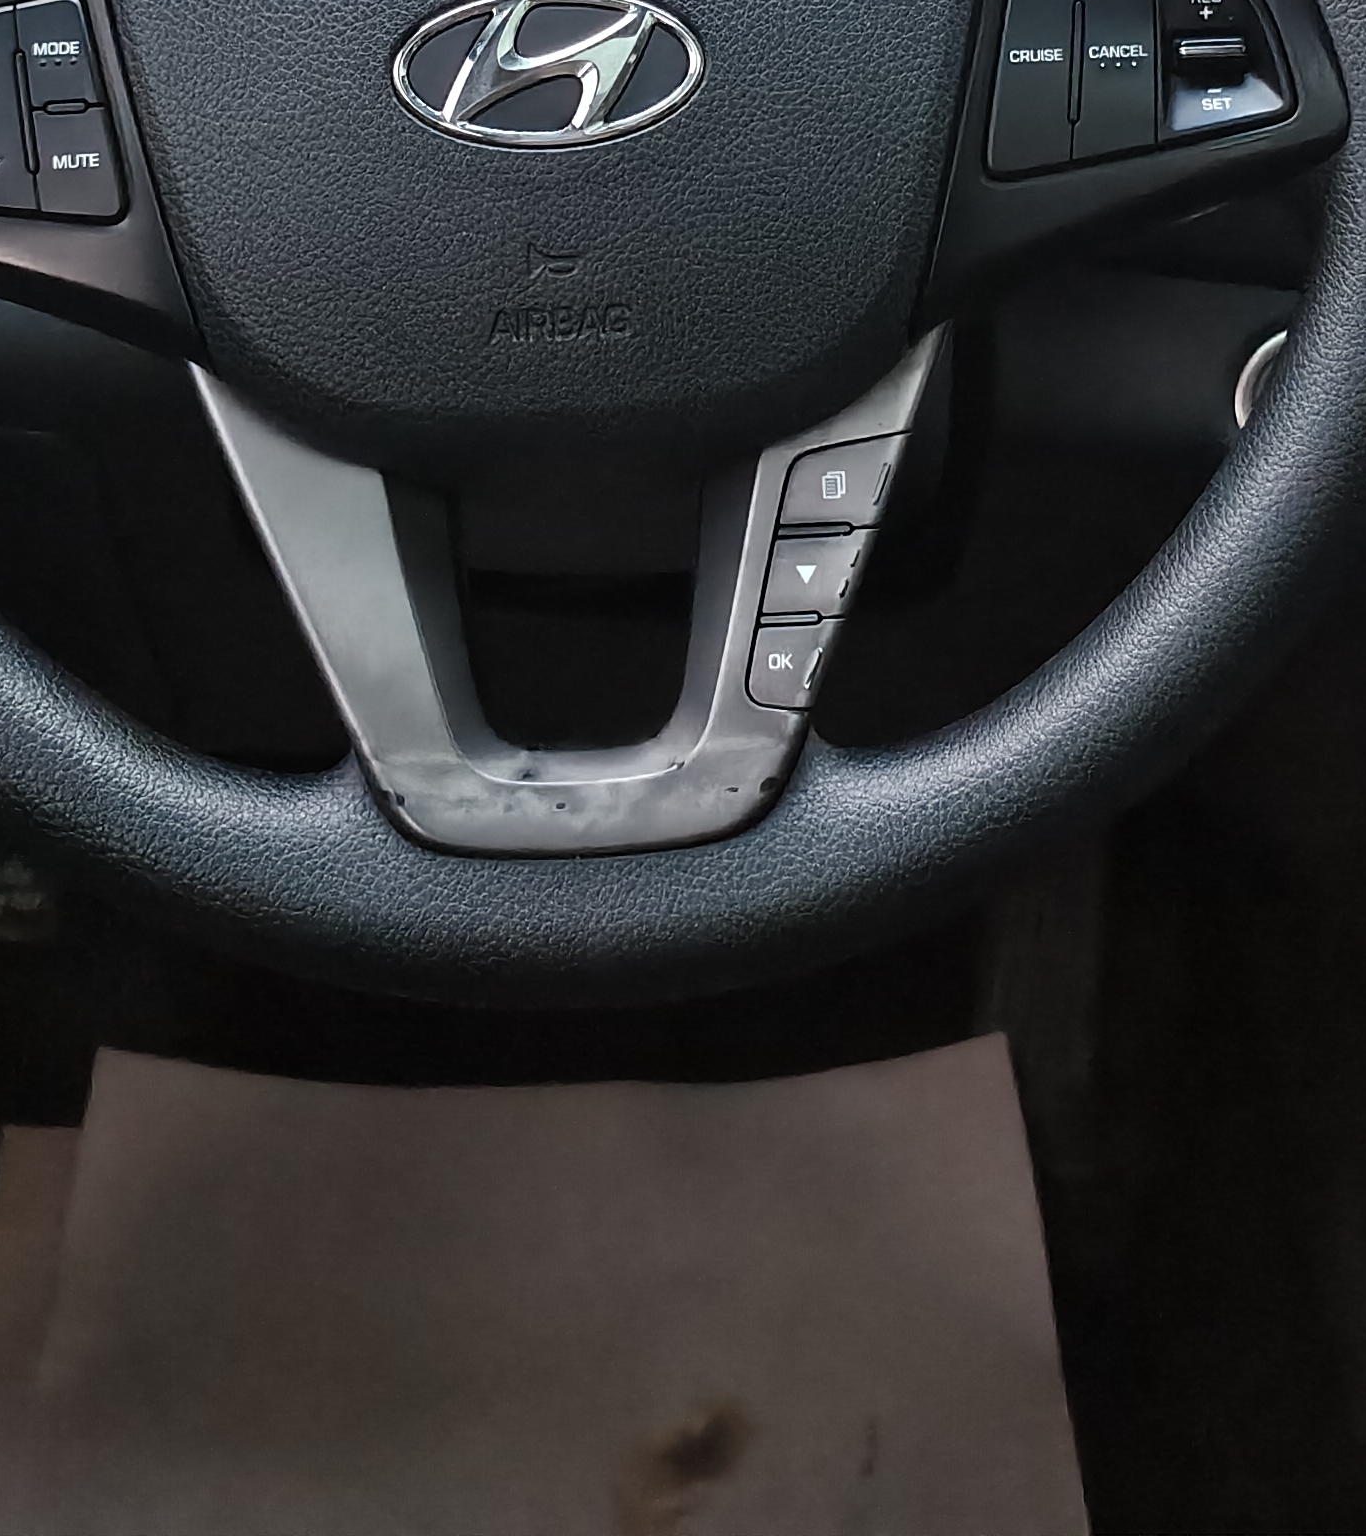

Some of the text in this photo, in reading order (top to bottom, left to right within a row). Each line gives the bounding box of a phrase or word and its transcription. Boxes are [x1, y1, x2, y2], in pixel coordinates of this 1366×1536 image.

[34, 41, 80, 57] MODE
[1009, 47, 1064, 64] CRUISE
[1088, 44, 1148, 60] CANCEL
[1201, 98, 1232, 111] SET
[52, 153, 100, 169] MUTE
[489, 303, 633, 344] AIRBAG
[768, 654, 794, 670] OK
